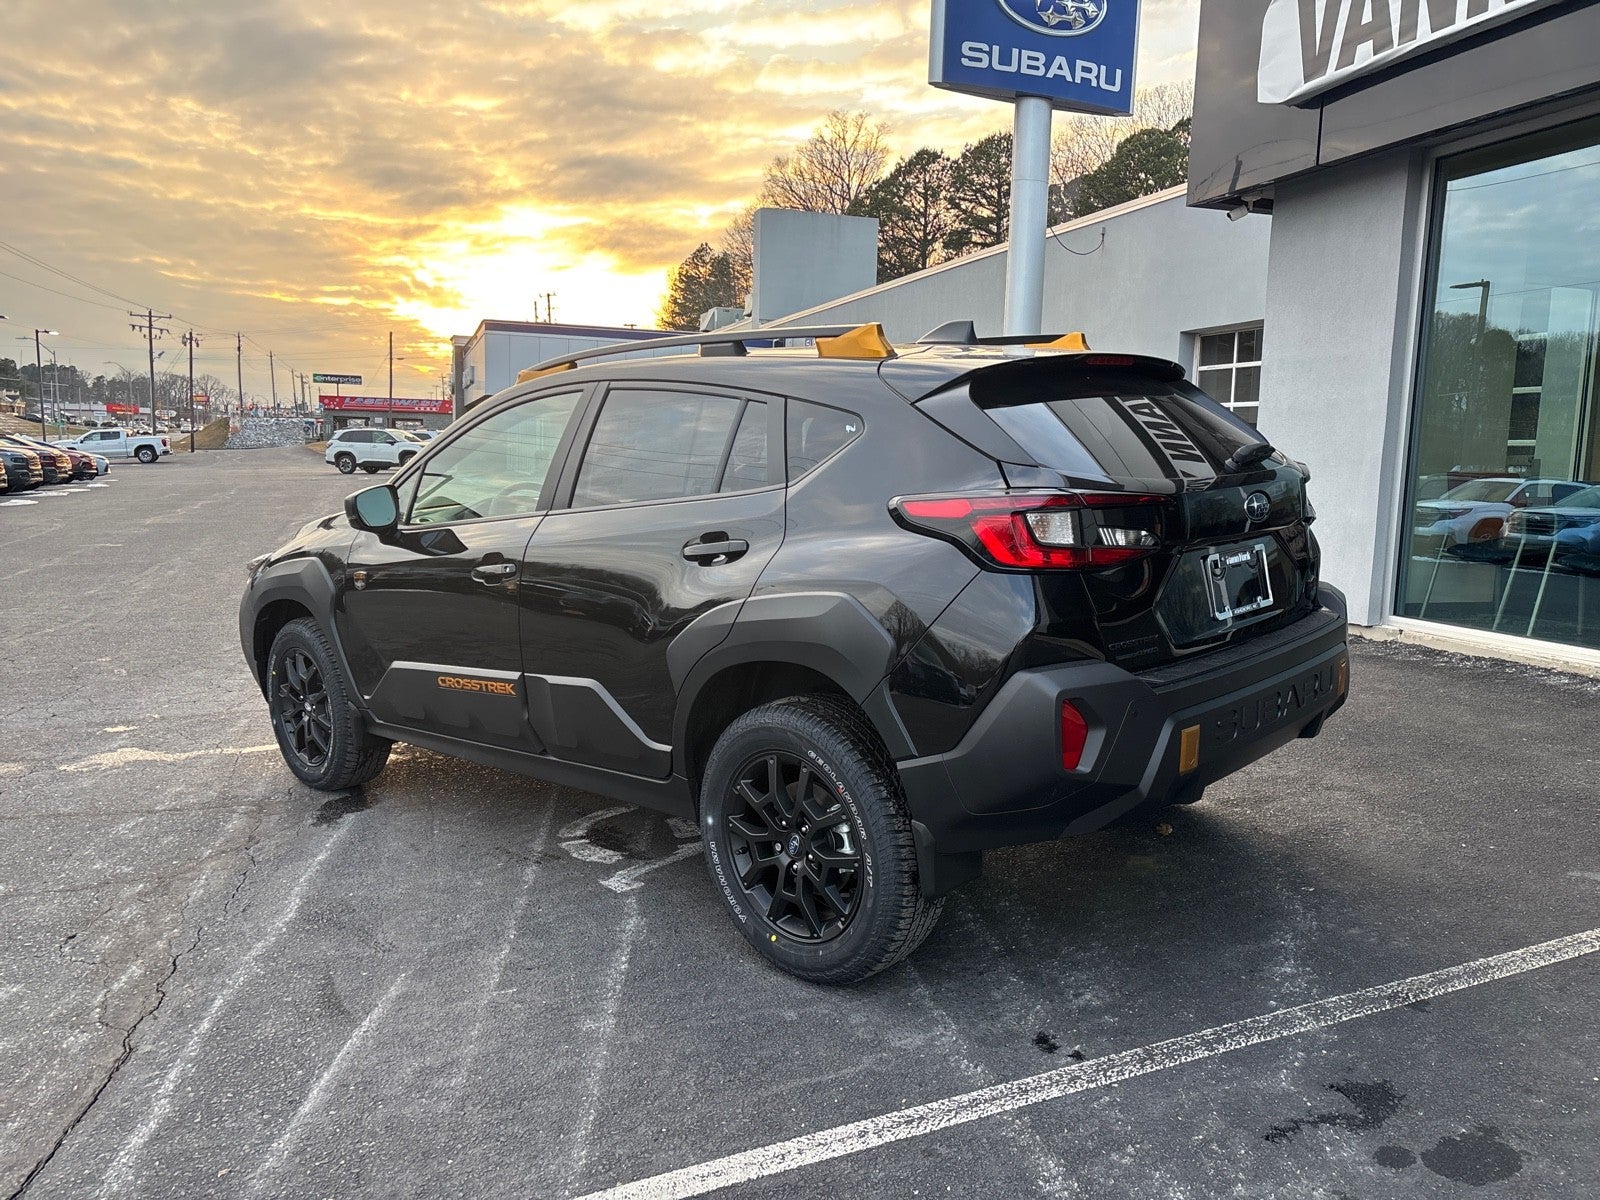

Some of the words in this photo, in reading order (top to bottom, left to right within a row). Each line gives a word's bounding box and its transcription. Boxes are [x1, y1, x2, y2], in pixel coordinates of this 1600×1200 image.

[961, 41, 1122, 92] SUBARU
[1298, 0, 1516, 84] VA
[315, 375, 361, 383] enterprise
[438, 676, 516, 696] CROSSTREK
[1215, 664, 1334, 744] SUBARU
[807, 750, 867, 841] GEOLANDAR
[864, 852, 874, 888] A/T
[709, 841, 747, 924] YOKOHAMA
